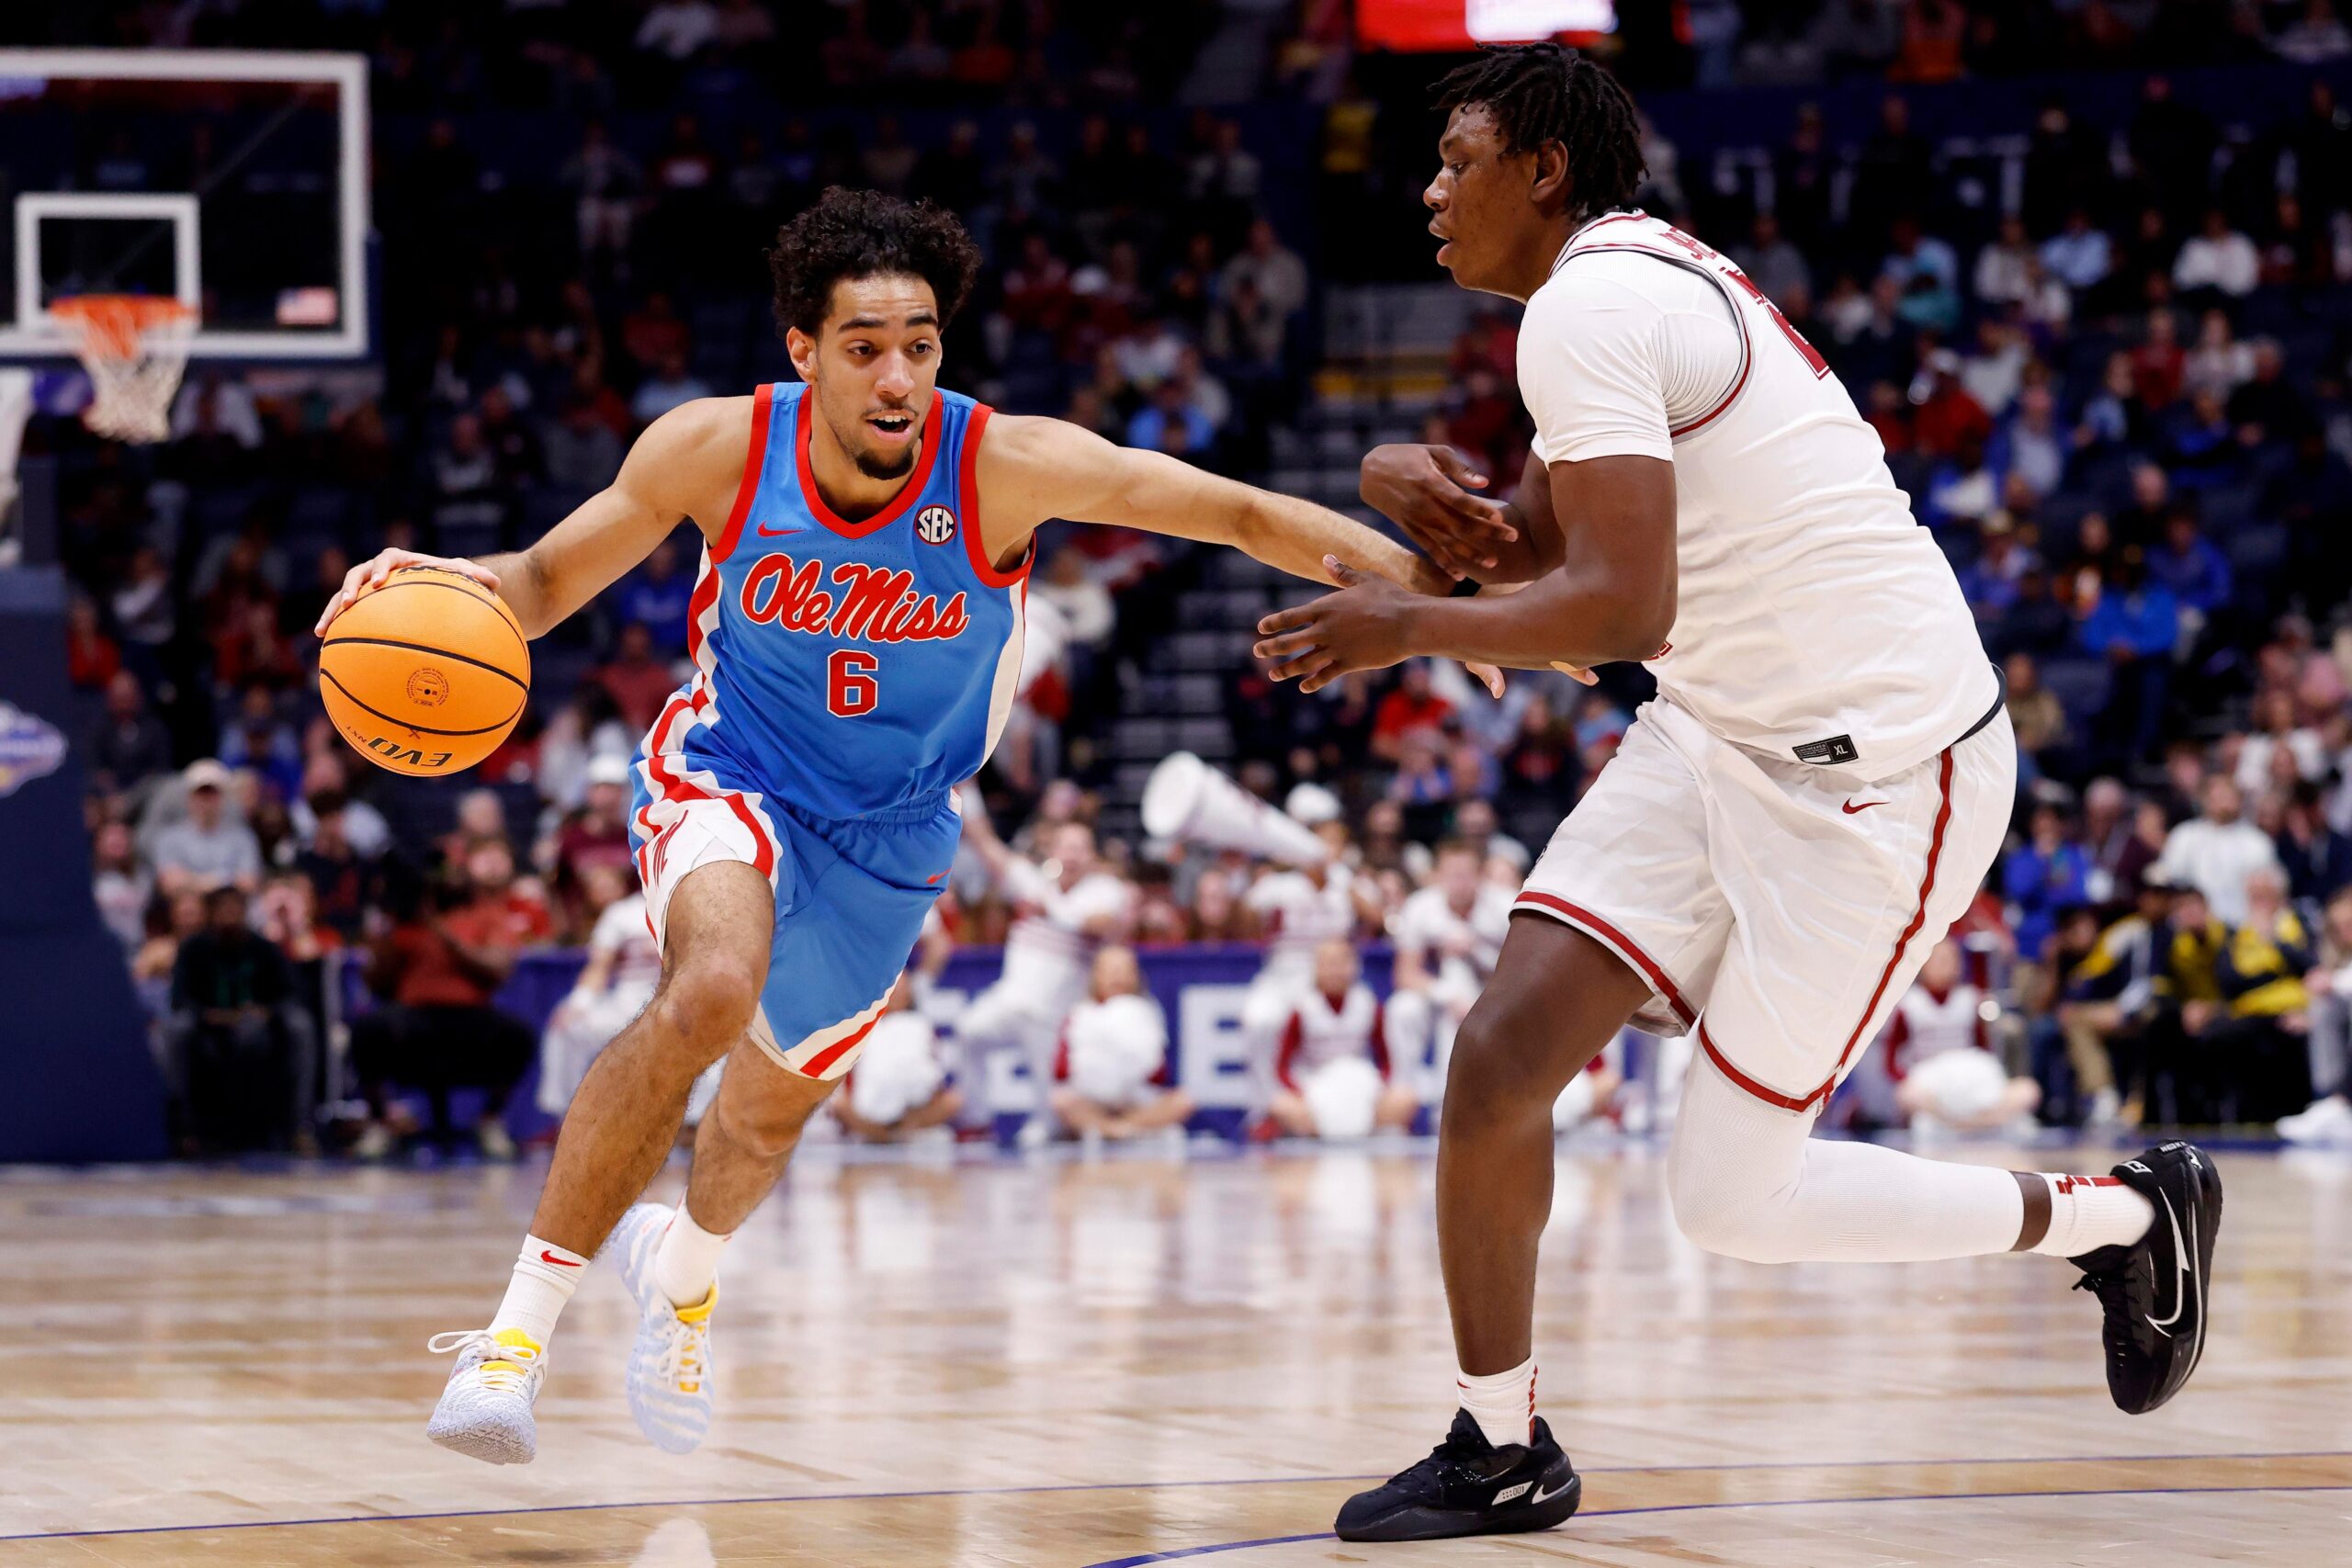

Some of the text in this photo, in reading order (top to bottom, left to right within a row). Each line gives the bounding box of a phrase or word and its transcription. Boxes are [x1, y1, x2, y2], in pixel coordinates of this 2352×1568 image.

[918, 507, 955, 543] SEC
[741, 552, 971, 643] Ole Miss
[827, 649, 878, 717] 6
[368, 737, 453, 767] EVO
[1833, 744, 1849, 756] XL
